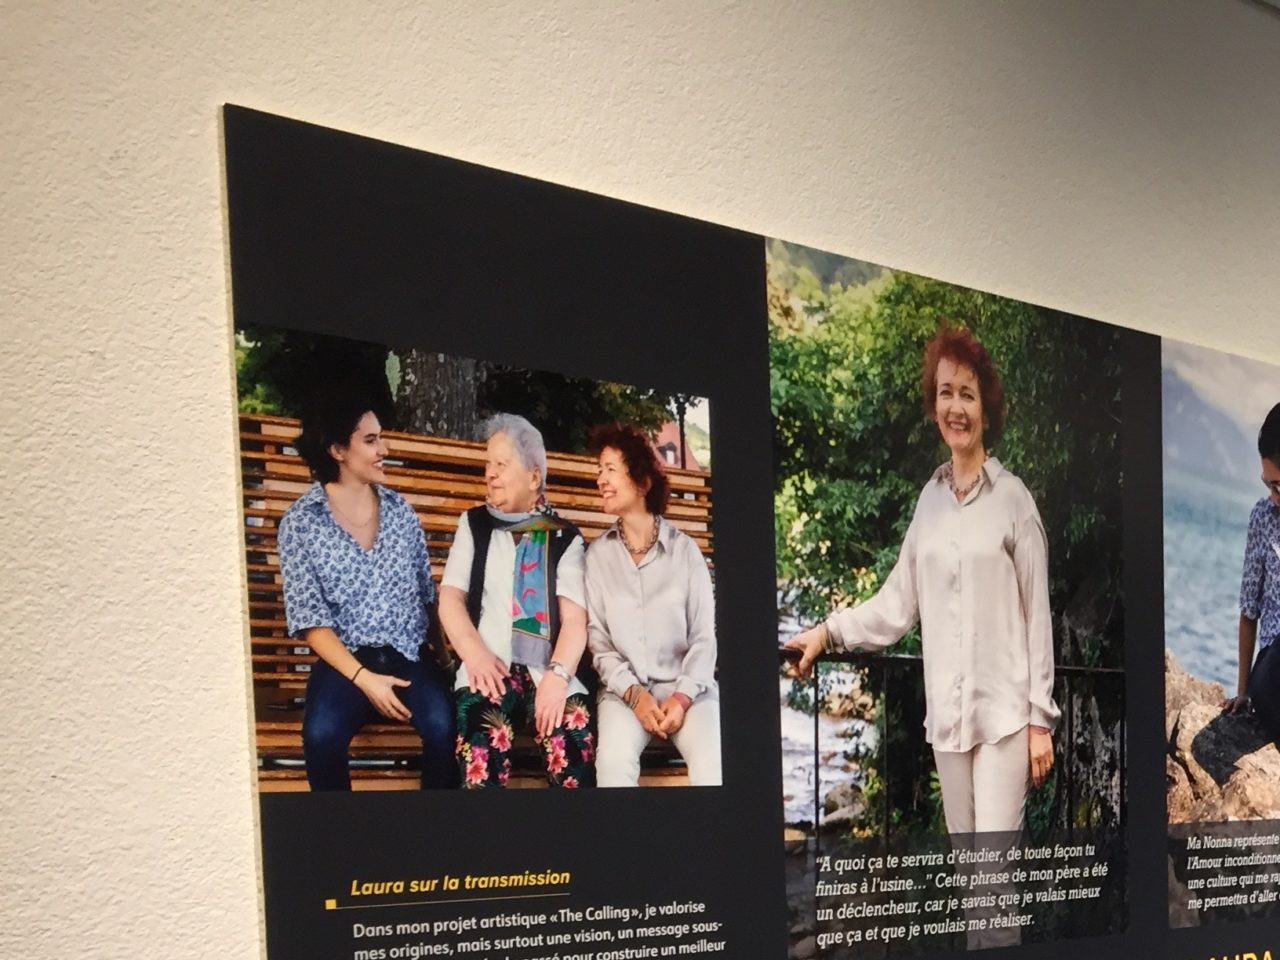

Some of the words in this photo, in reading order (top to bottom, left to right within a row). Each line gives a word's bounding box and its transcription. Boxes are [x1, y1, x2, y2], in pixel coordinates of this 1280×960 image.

[1185, 835, 1202, 850] Ma
[1202, 835, 1233, 849] Nonna
[1232, 832, 1280, 850] représente
[833, 853, 866, 876] quoi
[867, 856, 883, 874] ça
[886, 853, 899, 868] te
[900, 850, 944, 867] servira
[946, 847, 1003, 864] d'étudier,
[1006, 845, 1022, 861] de
[1023, 845, 1052, 860] toute
[1053, 843, 1083, 861] façon
[1084, 842, 1096, 856] tu
[1186, 855, 1224, 870] l'Amour
[350, 879, 405, 896] Laura
[409, 879, 439, 893] sur
[442, 874, 460, 891] la
[464, 868, 570, 889] transmission
[814, 879, 858, 897] finiras
[859, 877, 868, 894] à
[934, 872, 968, 888] Cette
[968, 869, 1010, 890] phrase
[1011, 867, 1027, 883] de
[1028, 868, 1054, 881] mon
[1053, 864, 1081, 884] père
[1082, 866, 1090, 877] a
[1090, 861, 1109, 877] été
[353, 923, 393, 938] Dans
[395, 922, 430, 935] mon
[433, 916, 477, 936] projet
[479, 912, 547, 929] artistique
[643, 903, 657, 921] je
[658, 900, 706, 915] valorise
[816, 908, 834, 921] un
[836, 899, 921, 919] déclencheur,
[923, 899, 945, 912] car
[945, 894, 959, 914] je
[960, 891, 996, 909] savais
[997, 893, 1020, 909] que
[1020, 889, 1033, 907] je
[1035, 886, 1067, 902] valais
[1067, 884, 1101, 900] mieux
[816, 931, 844, 950] que
[845, 929, 862, 947] ça
[864, 925, 879, 941] et
[880, 925, 906, 943] que
[906, 921, 921, 941] je
[923, 916, 966, 935] voulais
[967, 918, 987, 931] me
[988, 911, 1035, 929] réaliser.
